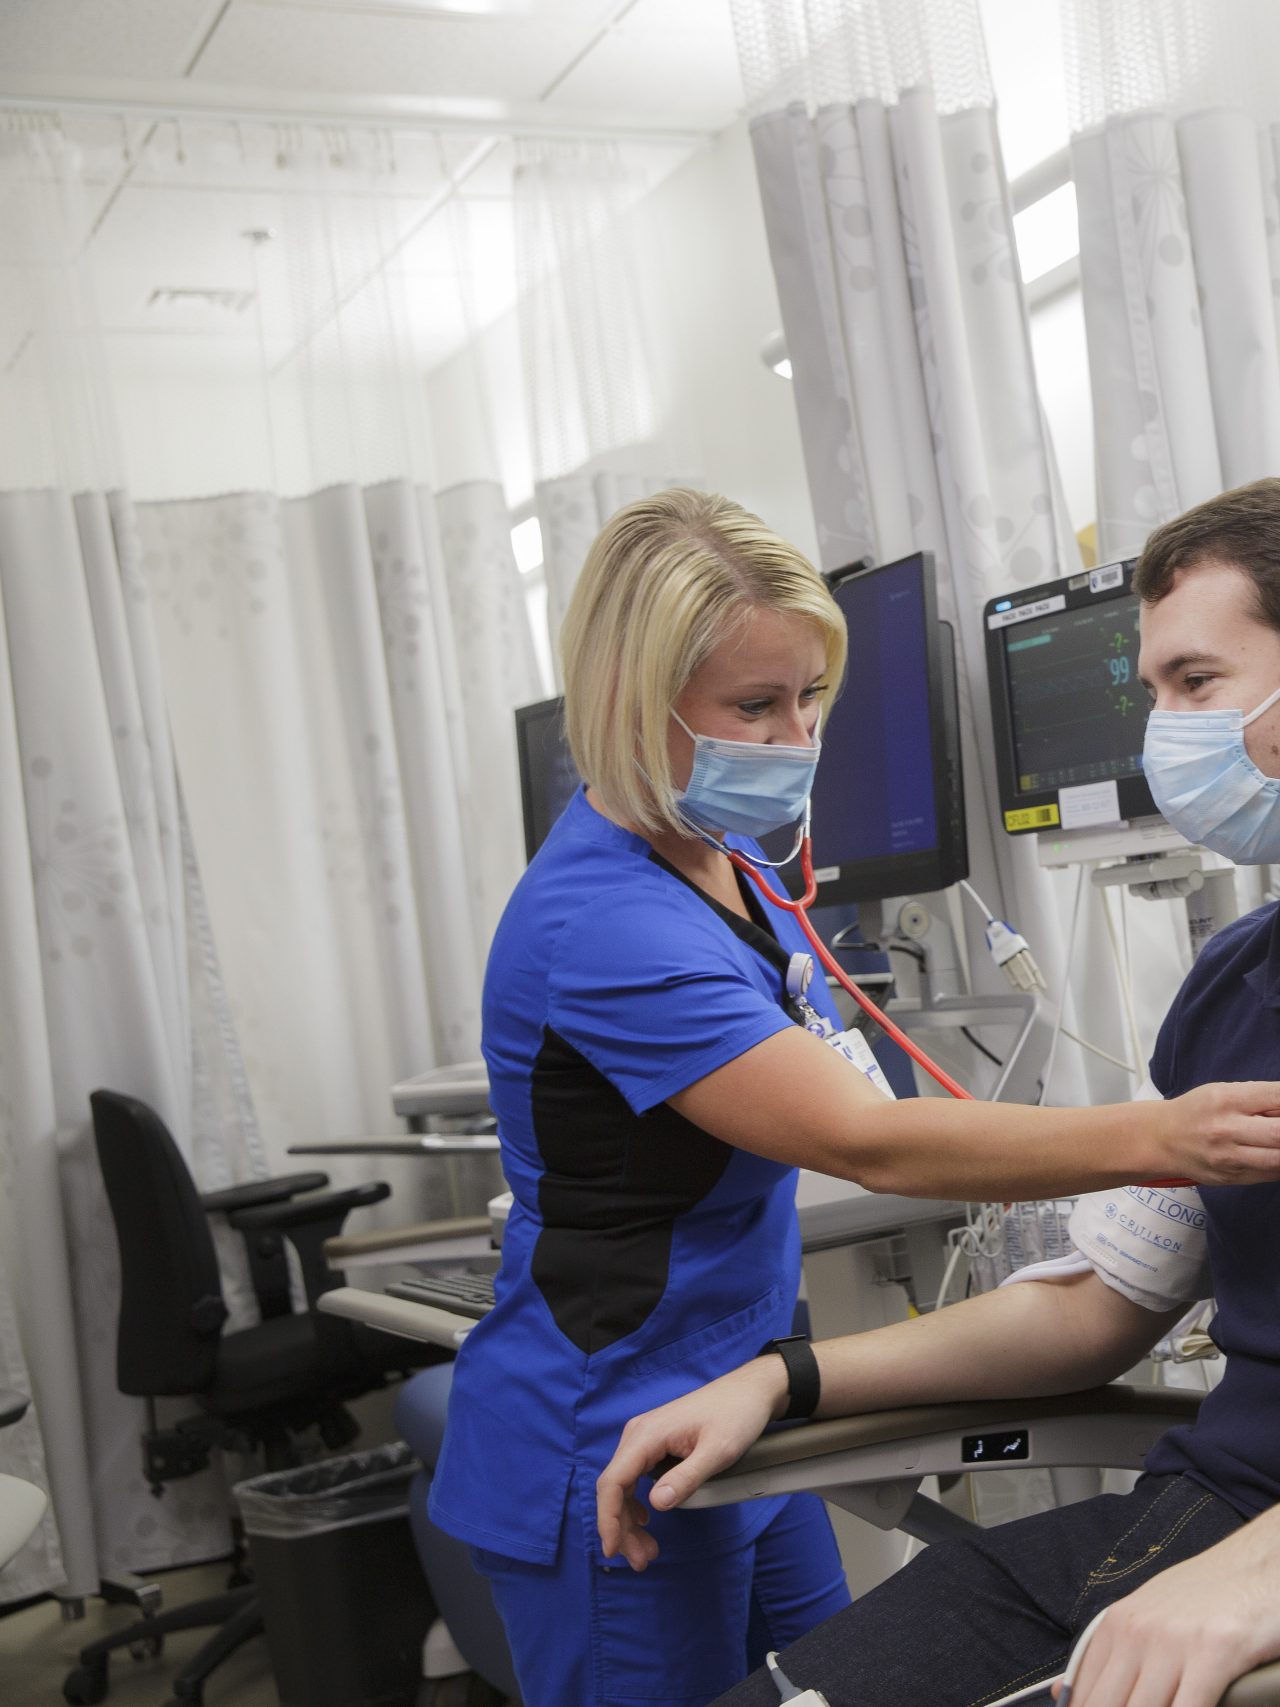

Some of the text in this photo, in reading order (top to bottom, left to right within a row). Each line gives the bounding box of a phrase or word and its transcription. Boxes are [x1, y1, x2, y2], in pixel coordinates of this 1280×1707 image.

[1110, 656, 1130, 686] 99
[1157, 1198, 1207, 1227] LONG
[1120, 1214, 1182, 1251] CRITIKON
